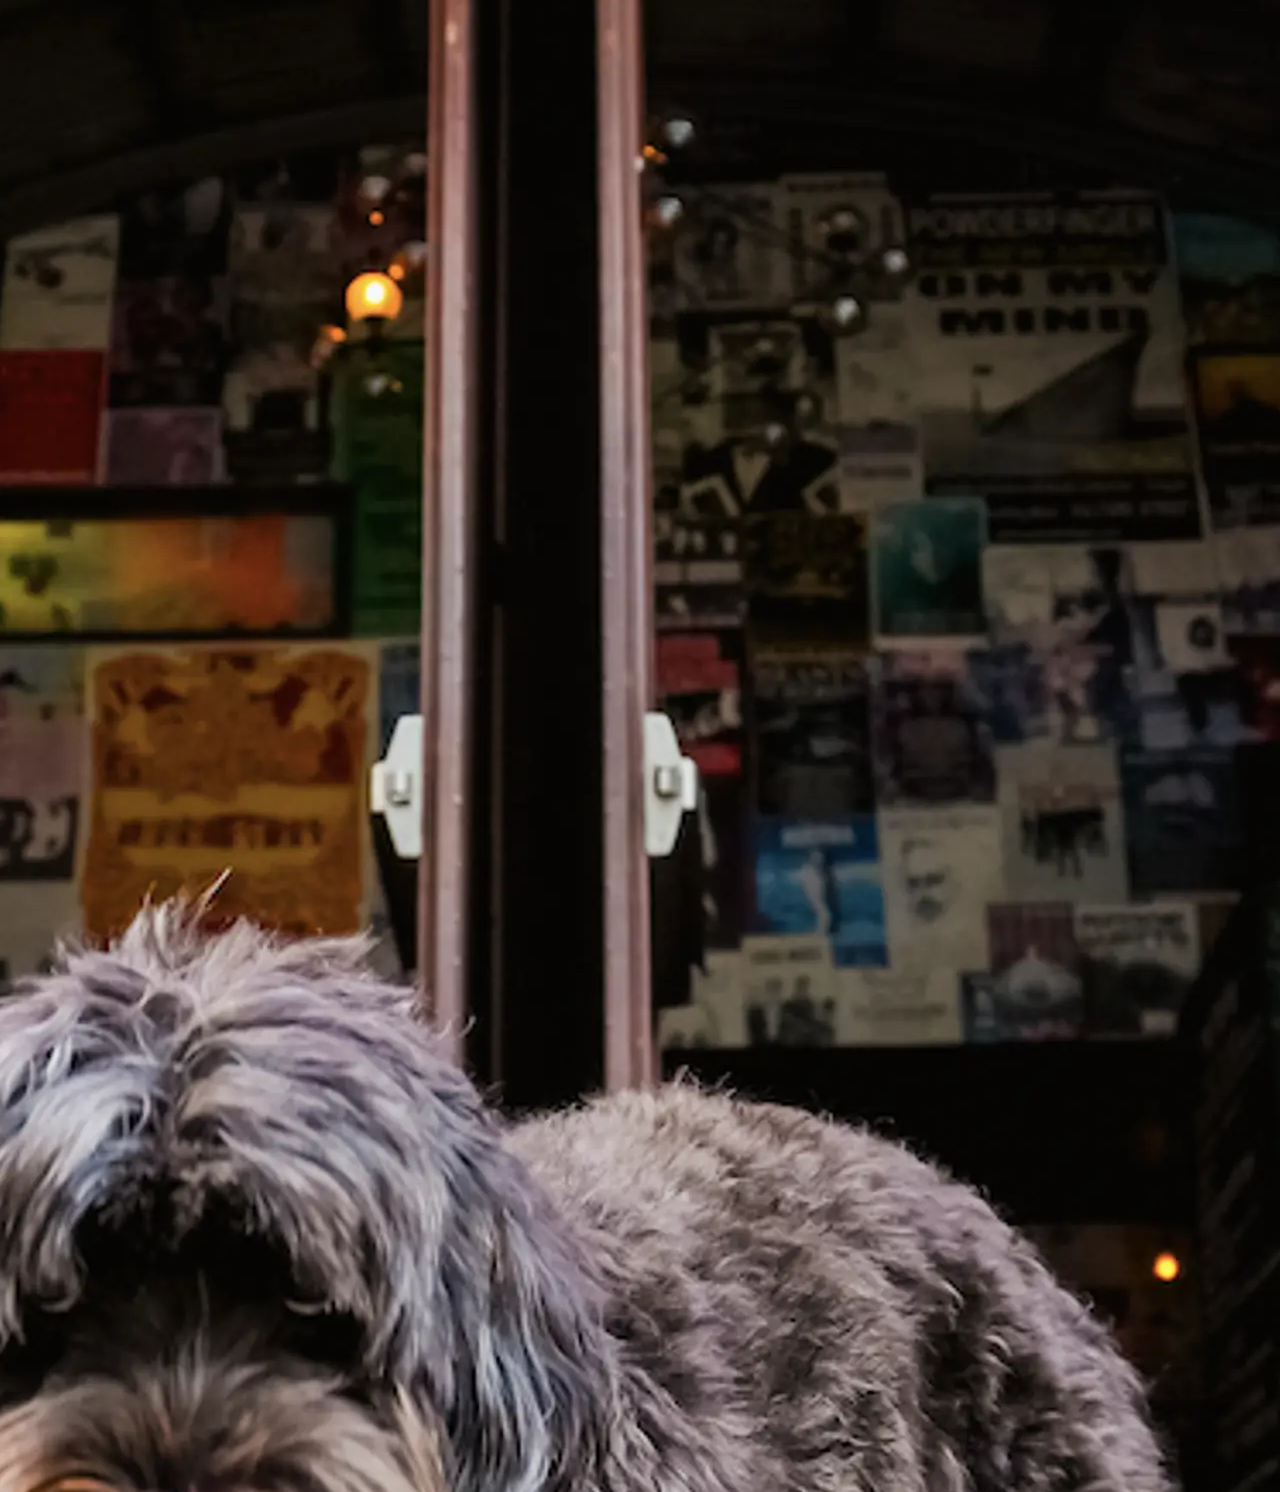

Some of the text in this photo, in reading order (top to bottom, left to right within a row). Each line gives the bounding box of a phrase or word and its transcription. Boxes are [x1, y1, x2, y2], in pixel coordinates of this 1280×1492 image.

[919, 270, 1158, 297] ON MY
[940, 307, 1149, 336] MIND
